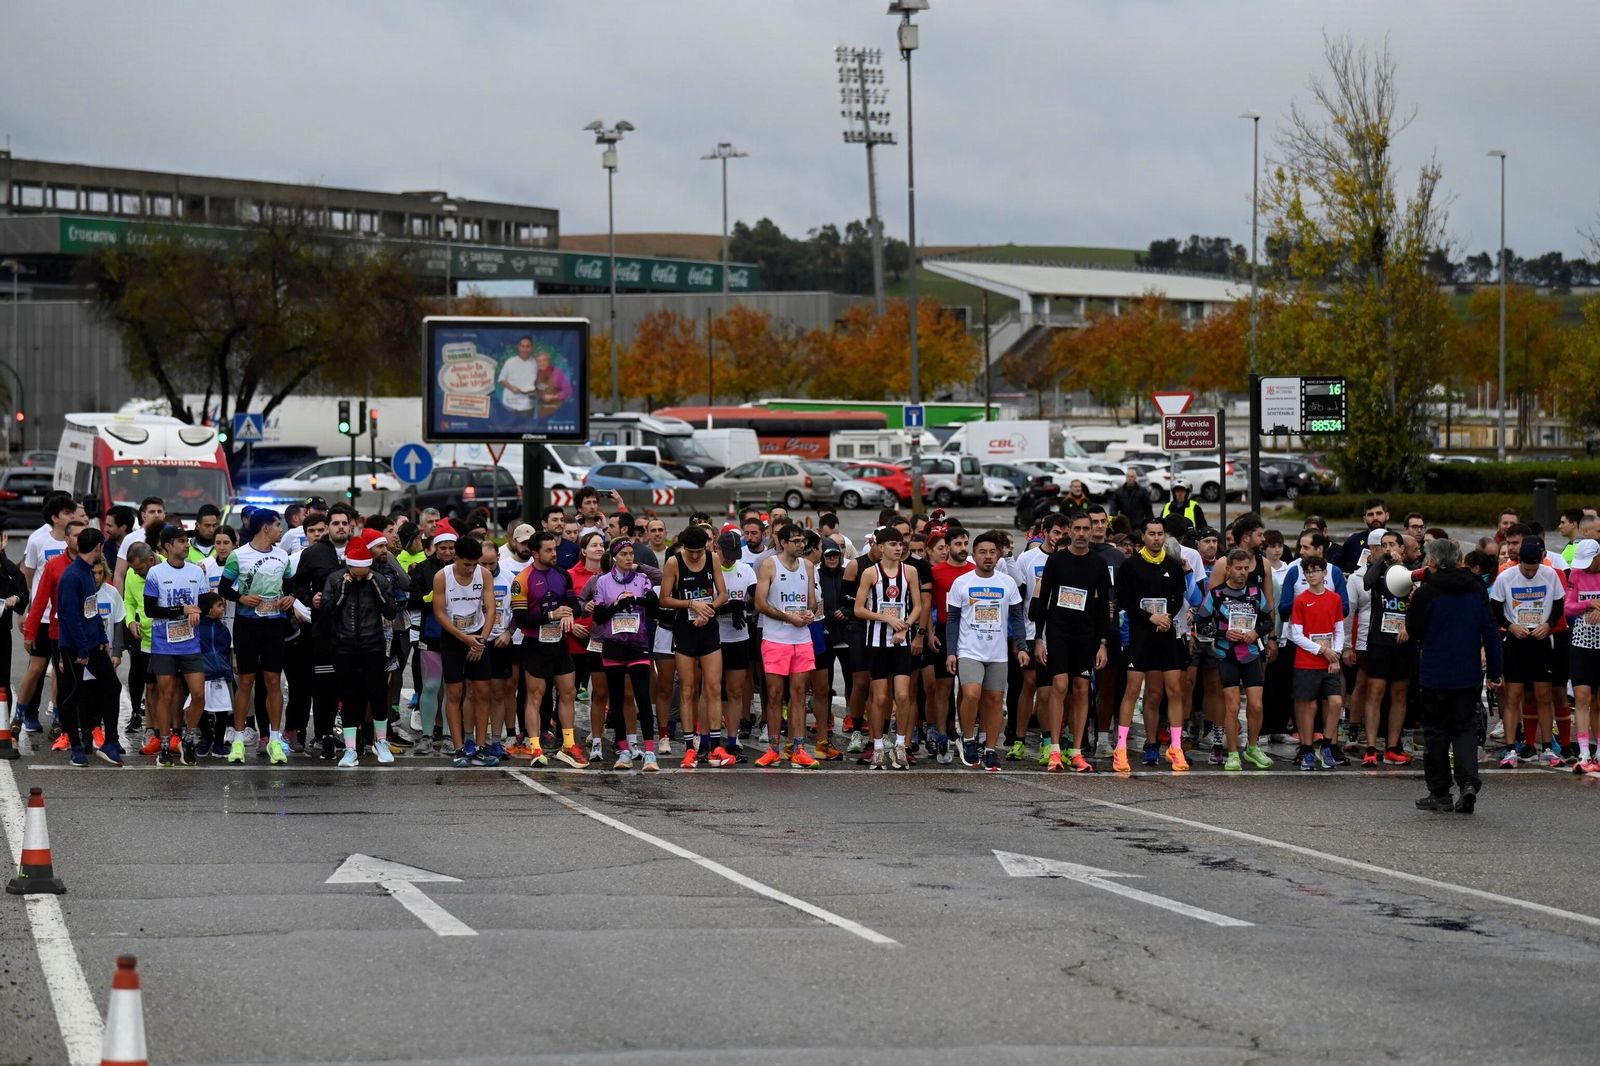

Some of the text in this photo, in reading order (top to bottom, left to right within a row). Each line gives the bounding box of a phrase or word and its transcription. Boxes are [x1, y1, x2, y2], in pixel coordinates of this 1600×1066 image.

[1329, 383, 1342, 395] 16
[1181, 420, 1210, 428] Avenida
[1312, 419, 1341, 431] 88534
[1170, 430, 1210, 438] Compositor
[1190, 438, 1213, 446] Castro
[780, 591, 807, 602] indea
